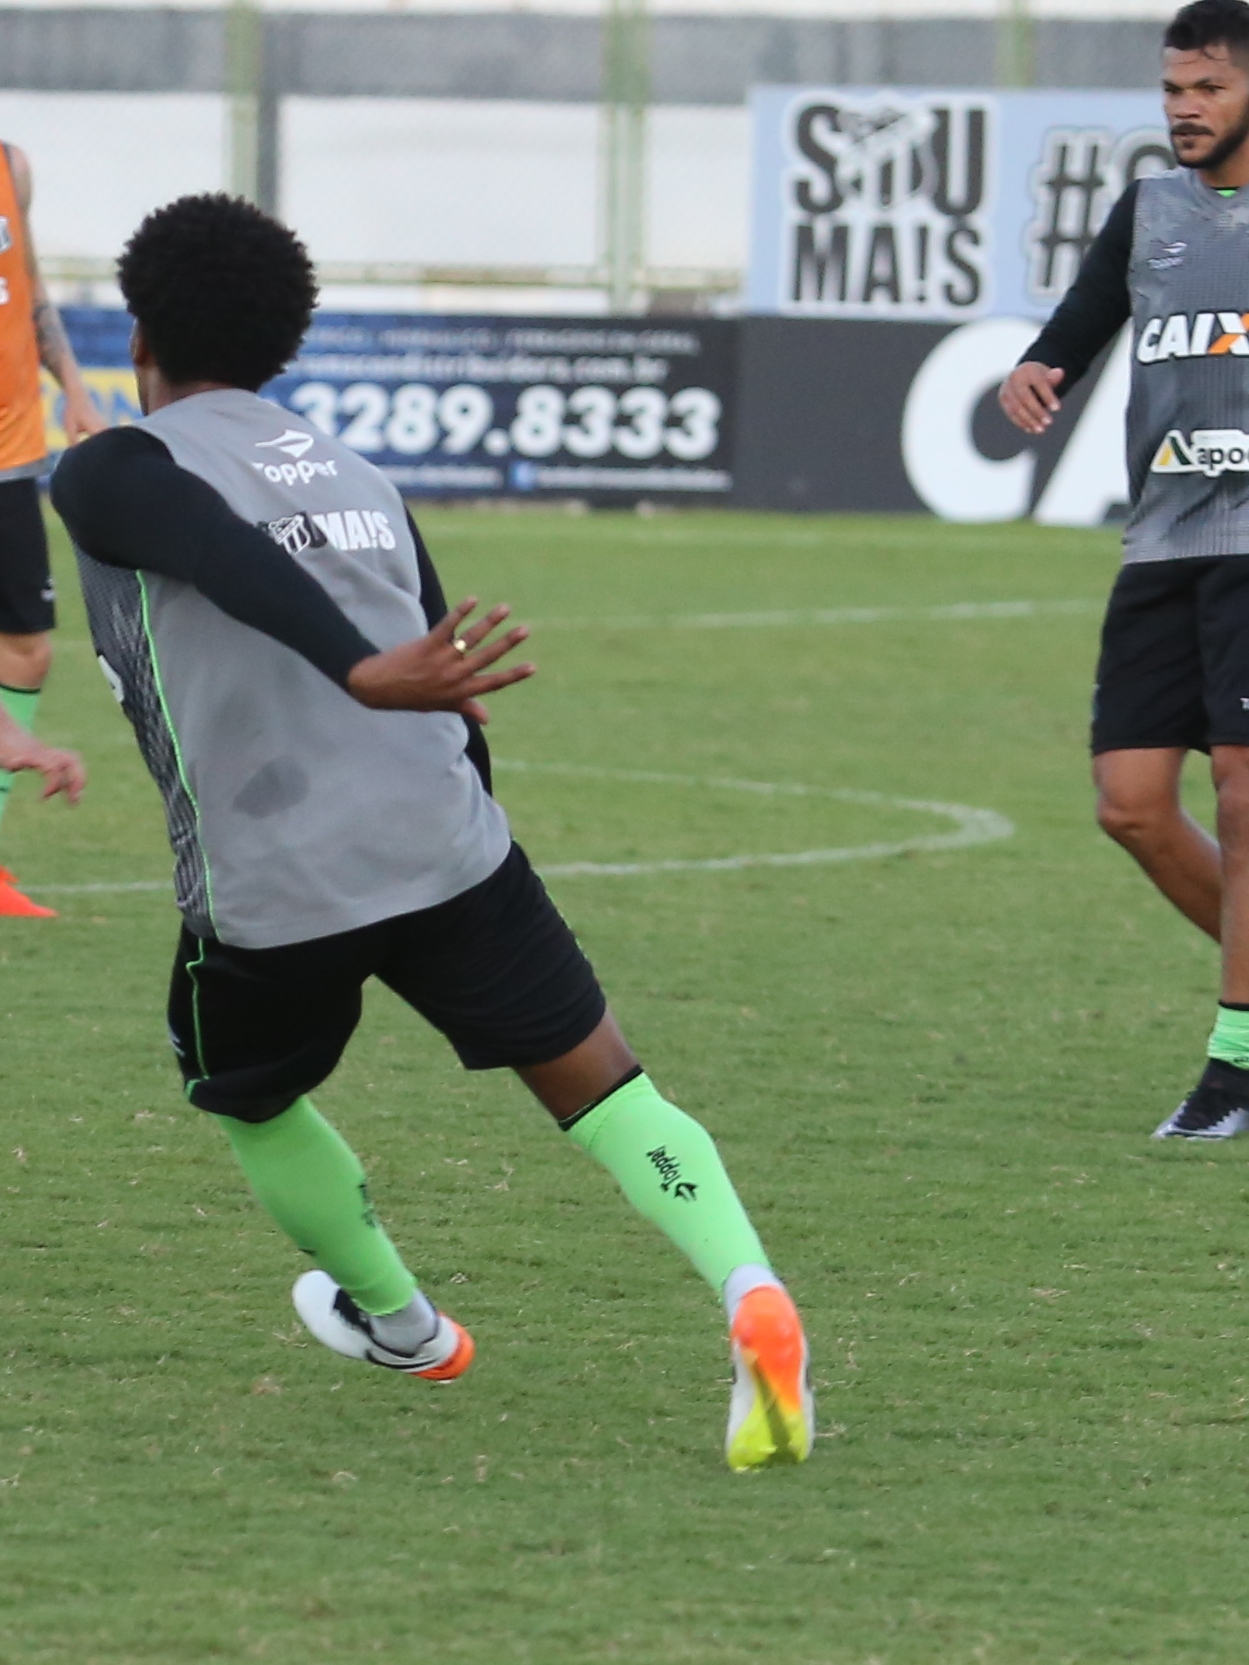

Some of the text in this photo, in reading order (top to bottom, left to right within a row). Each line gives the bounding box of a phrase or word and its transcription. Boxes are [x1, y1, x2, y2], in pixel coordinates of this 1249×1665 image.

[292, 382, 721, 460] 3289.8333
[1197, 447, 1249, 470] apo
[646, 1145, 681, 1192] Topper
